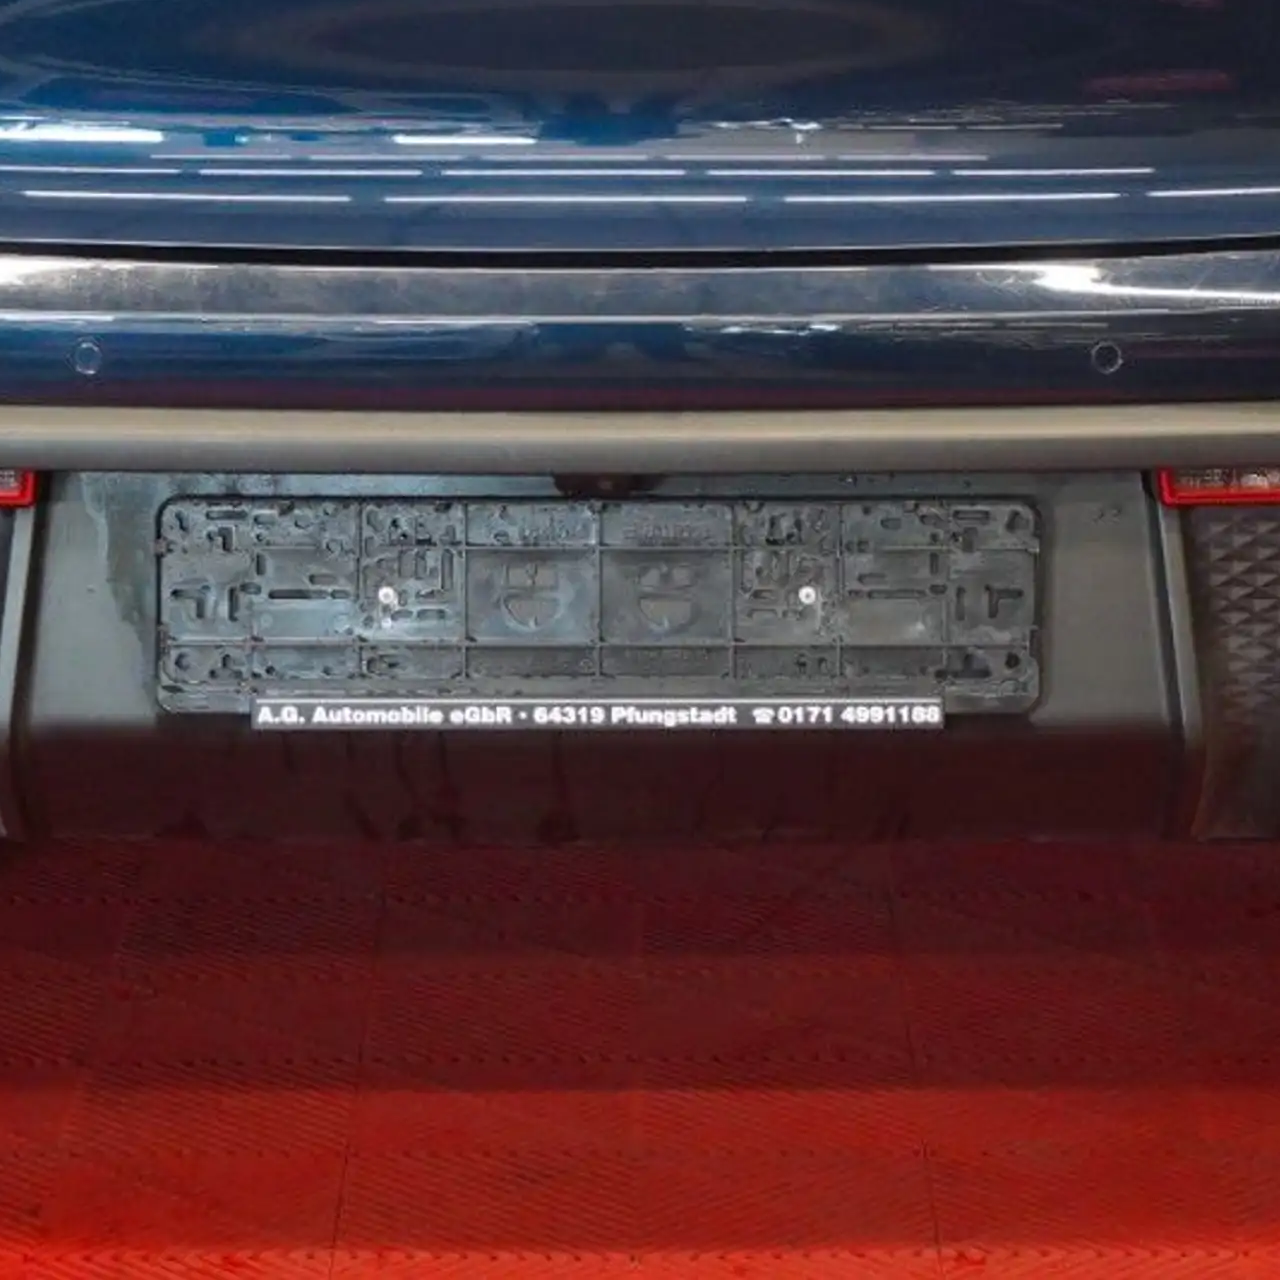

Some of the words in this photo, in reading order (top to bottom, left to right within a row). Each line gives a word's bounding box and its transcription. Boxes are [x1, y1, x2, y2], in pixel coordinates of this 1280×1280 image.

[257, 706, 306, 724] A.G.
[311, 705, 445, 724] Automobile
[450, 705, 513, 724] eGbR
[532, 706, 607, 724] 64319
[610, 705, 738, 727] Pfungstadt
[777, 705, 833, 724] 0171
